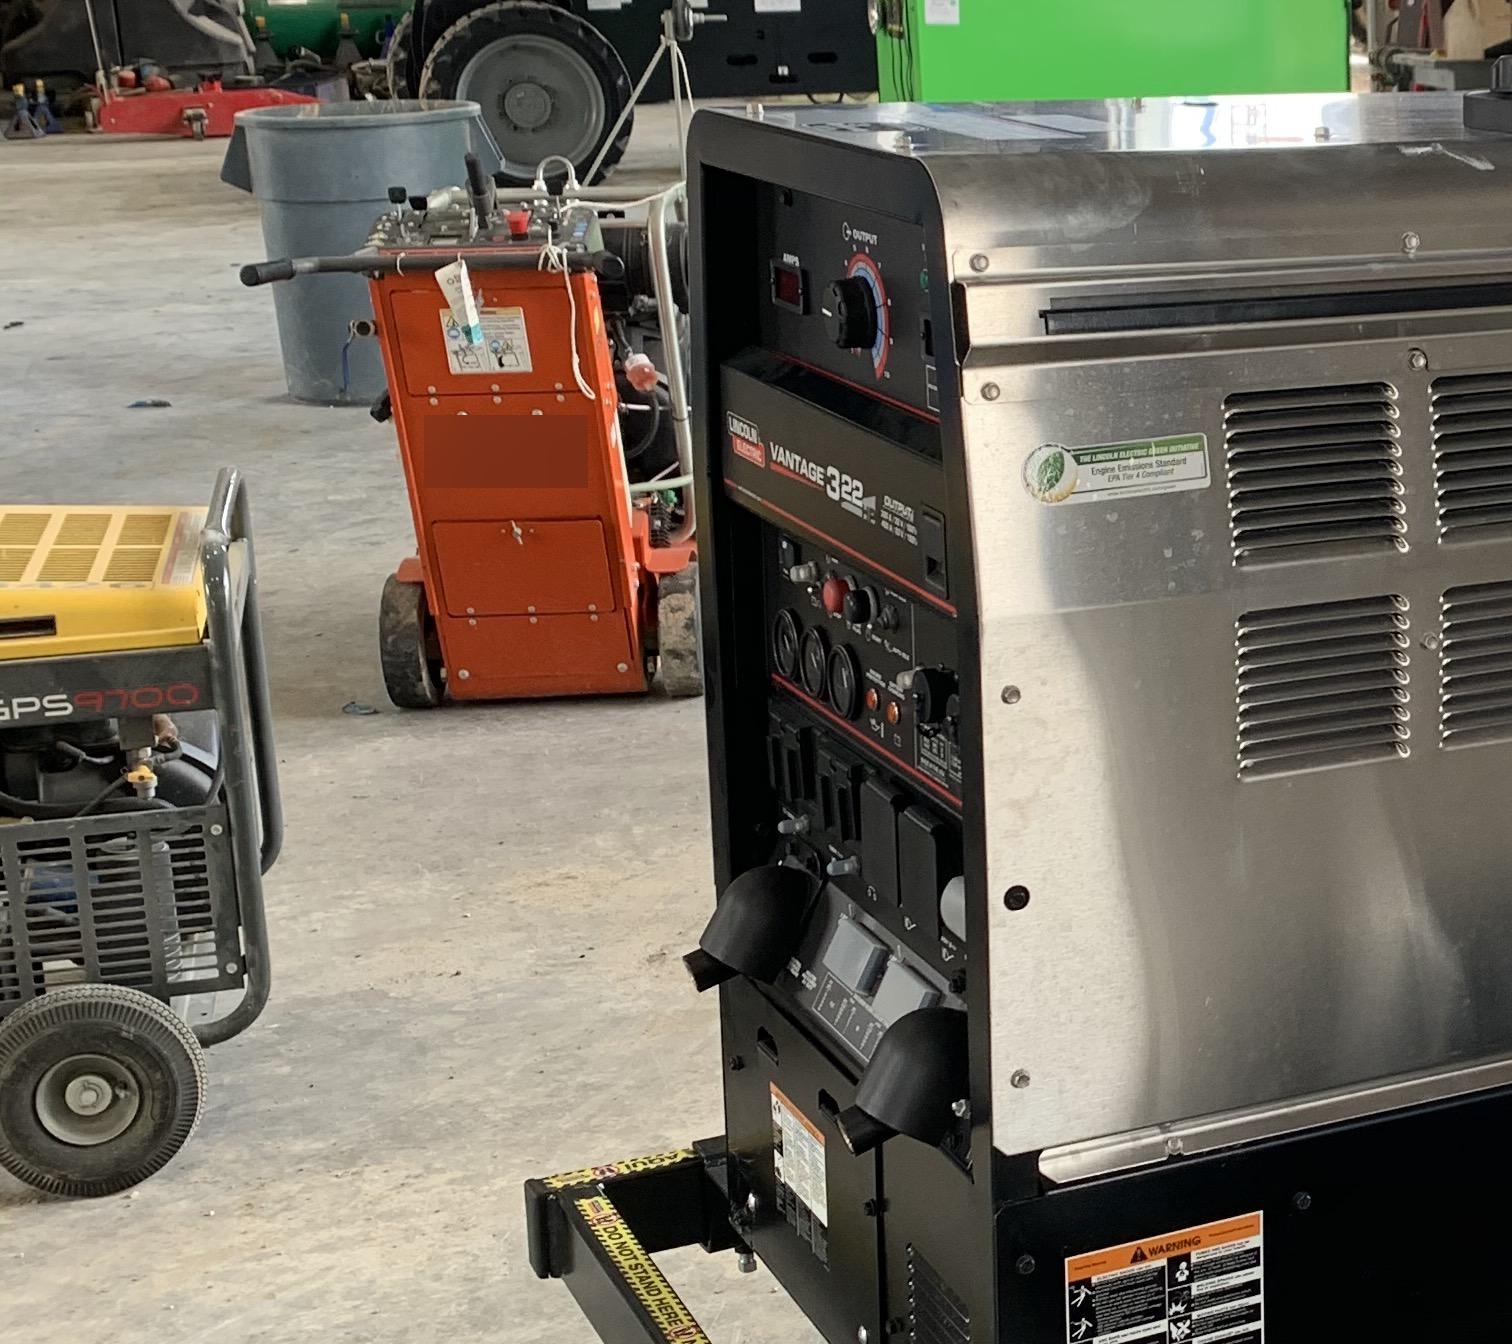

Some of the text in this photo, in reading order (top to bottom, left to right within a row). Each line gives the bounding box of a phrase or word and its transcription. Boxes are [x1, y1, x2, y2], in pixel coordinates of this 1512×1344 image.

[853, 229, 878, 245] OUTPUT
[782, 252, 800, 267] AMPS
[728, 415, 758, 444] LINCOLN
[1079, 454, 1091, 463] THE
[1092, 452, 1118, 462] LINCOLN
[1119, 449, 1147, 460] ELECTRIC
[769, 441, 864, 508] VANTAGE 322
[1091, 456, 1187, 477] Engine Emissions Standard
[1108, 474, 1121, 484] EPA
[1122, 473, 1134, 482] Tier
[1142, 468, 1175, 480] Compliant
[1147, 1236, 1202, 1256] WARNING
[603, 1225, 623, 1240] DO
[613, 1241, 639, 1262] NOT
[628, 1261, 662, 1297] STAND
[652, 1297, 684, 1327] HERE
